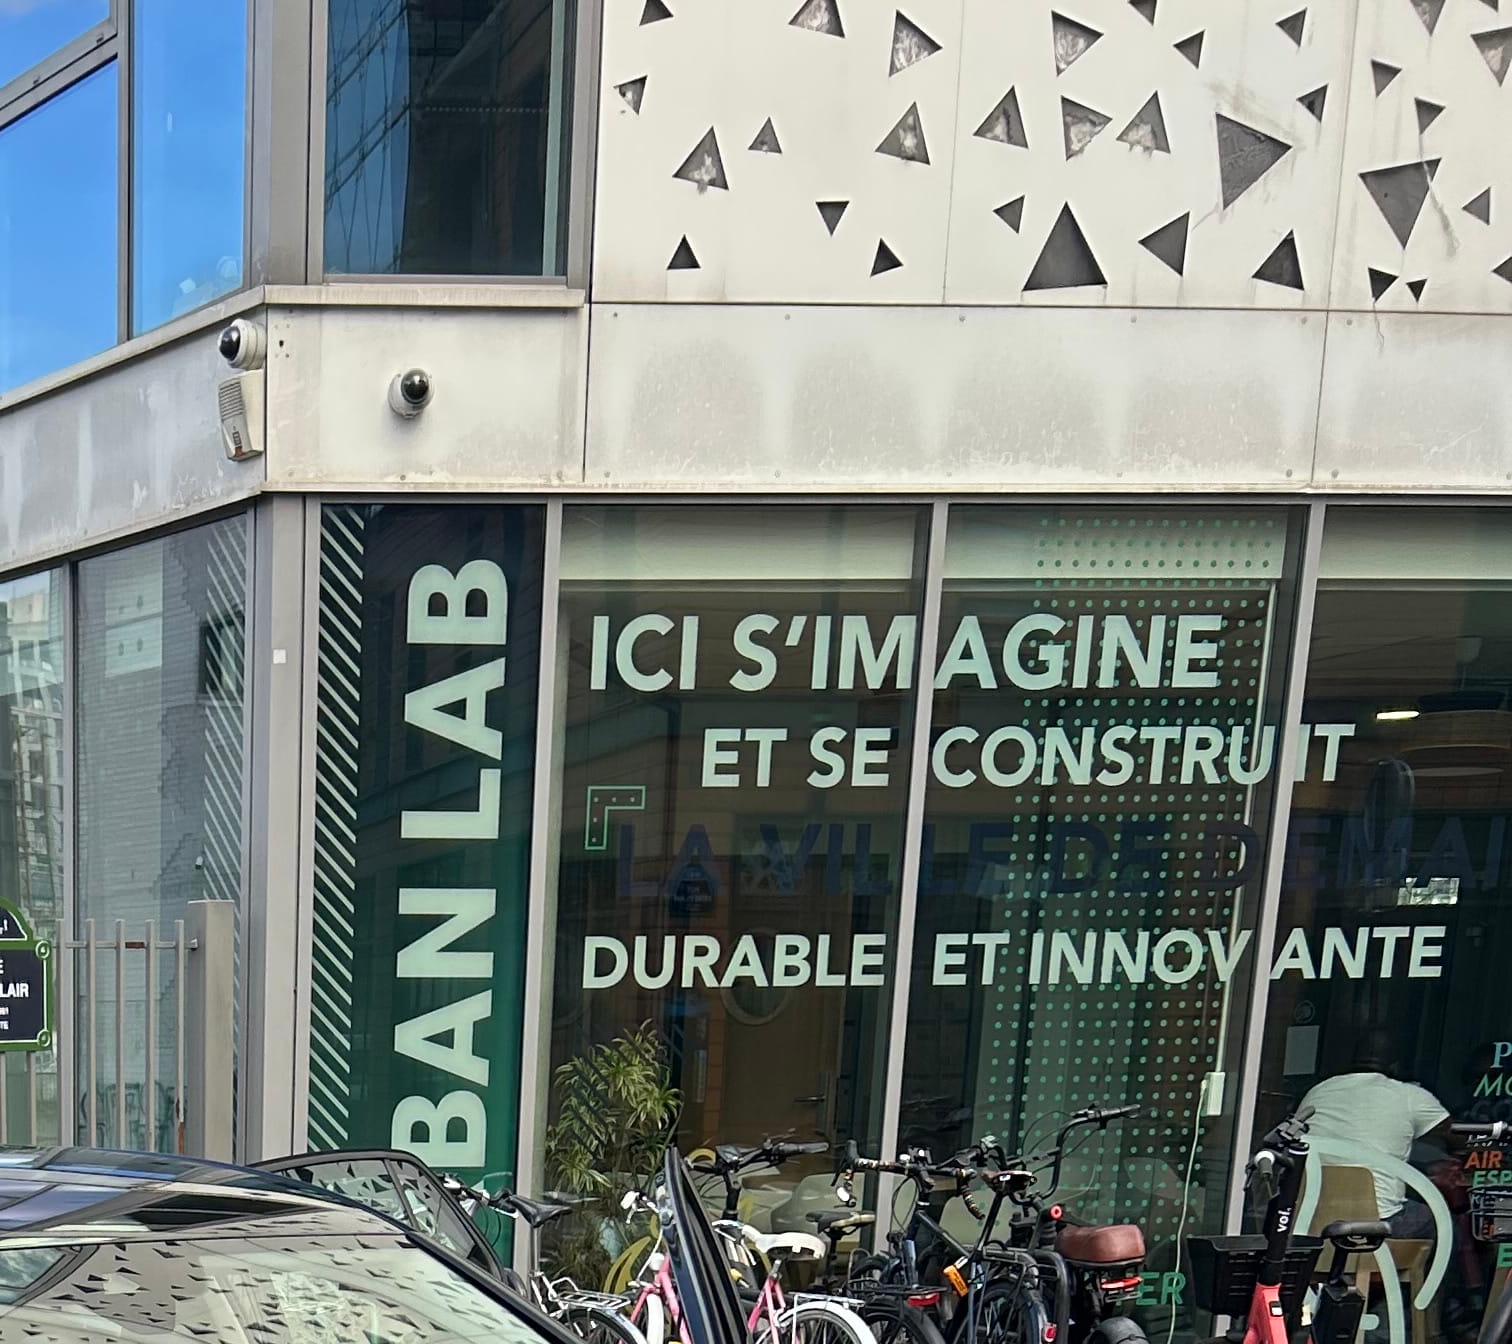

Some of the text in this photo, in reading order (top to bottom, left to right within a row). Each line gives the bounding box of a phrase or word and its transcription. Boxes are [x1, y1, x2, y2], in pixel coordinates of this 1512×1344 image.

[590, 613, 1223, 692] ICI S'IMAGINE
[701, 723, 1356, 788] ET SE CONSTRUIT
[617, 822, 724, 897] LA
[1048, 821, 1168, 894] DE
[1202, 816, 1507, 891] DEMAI
[582, 926, 1446, 991] DURABLE ET INNOVANTE
